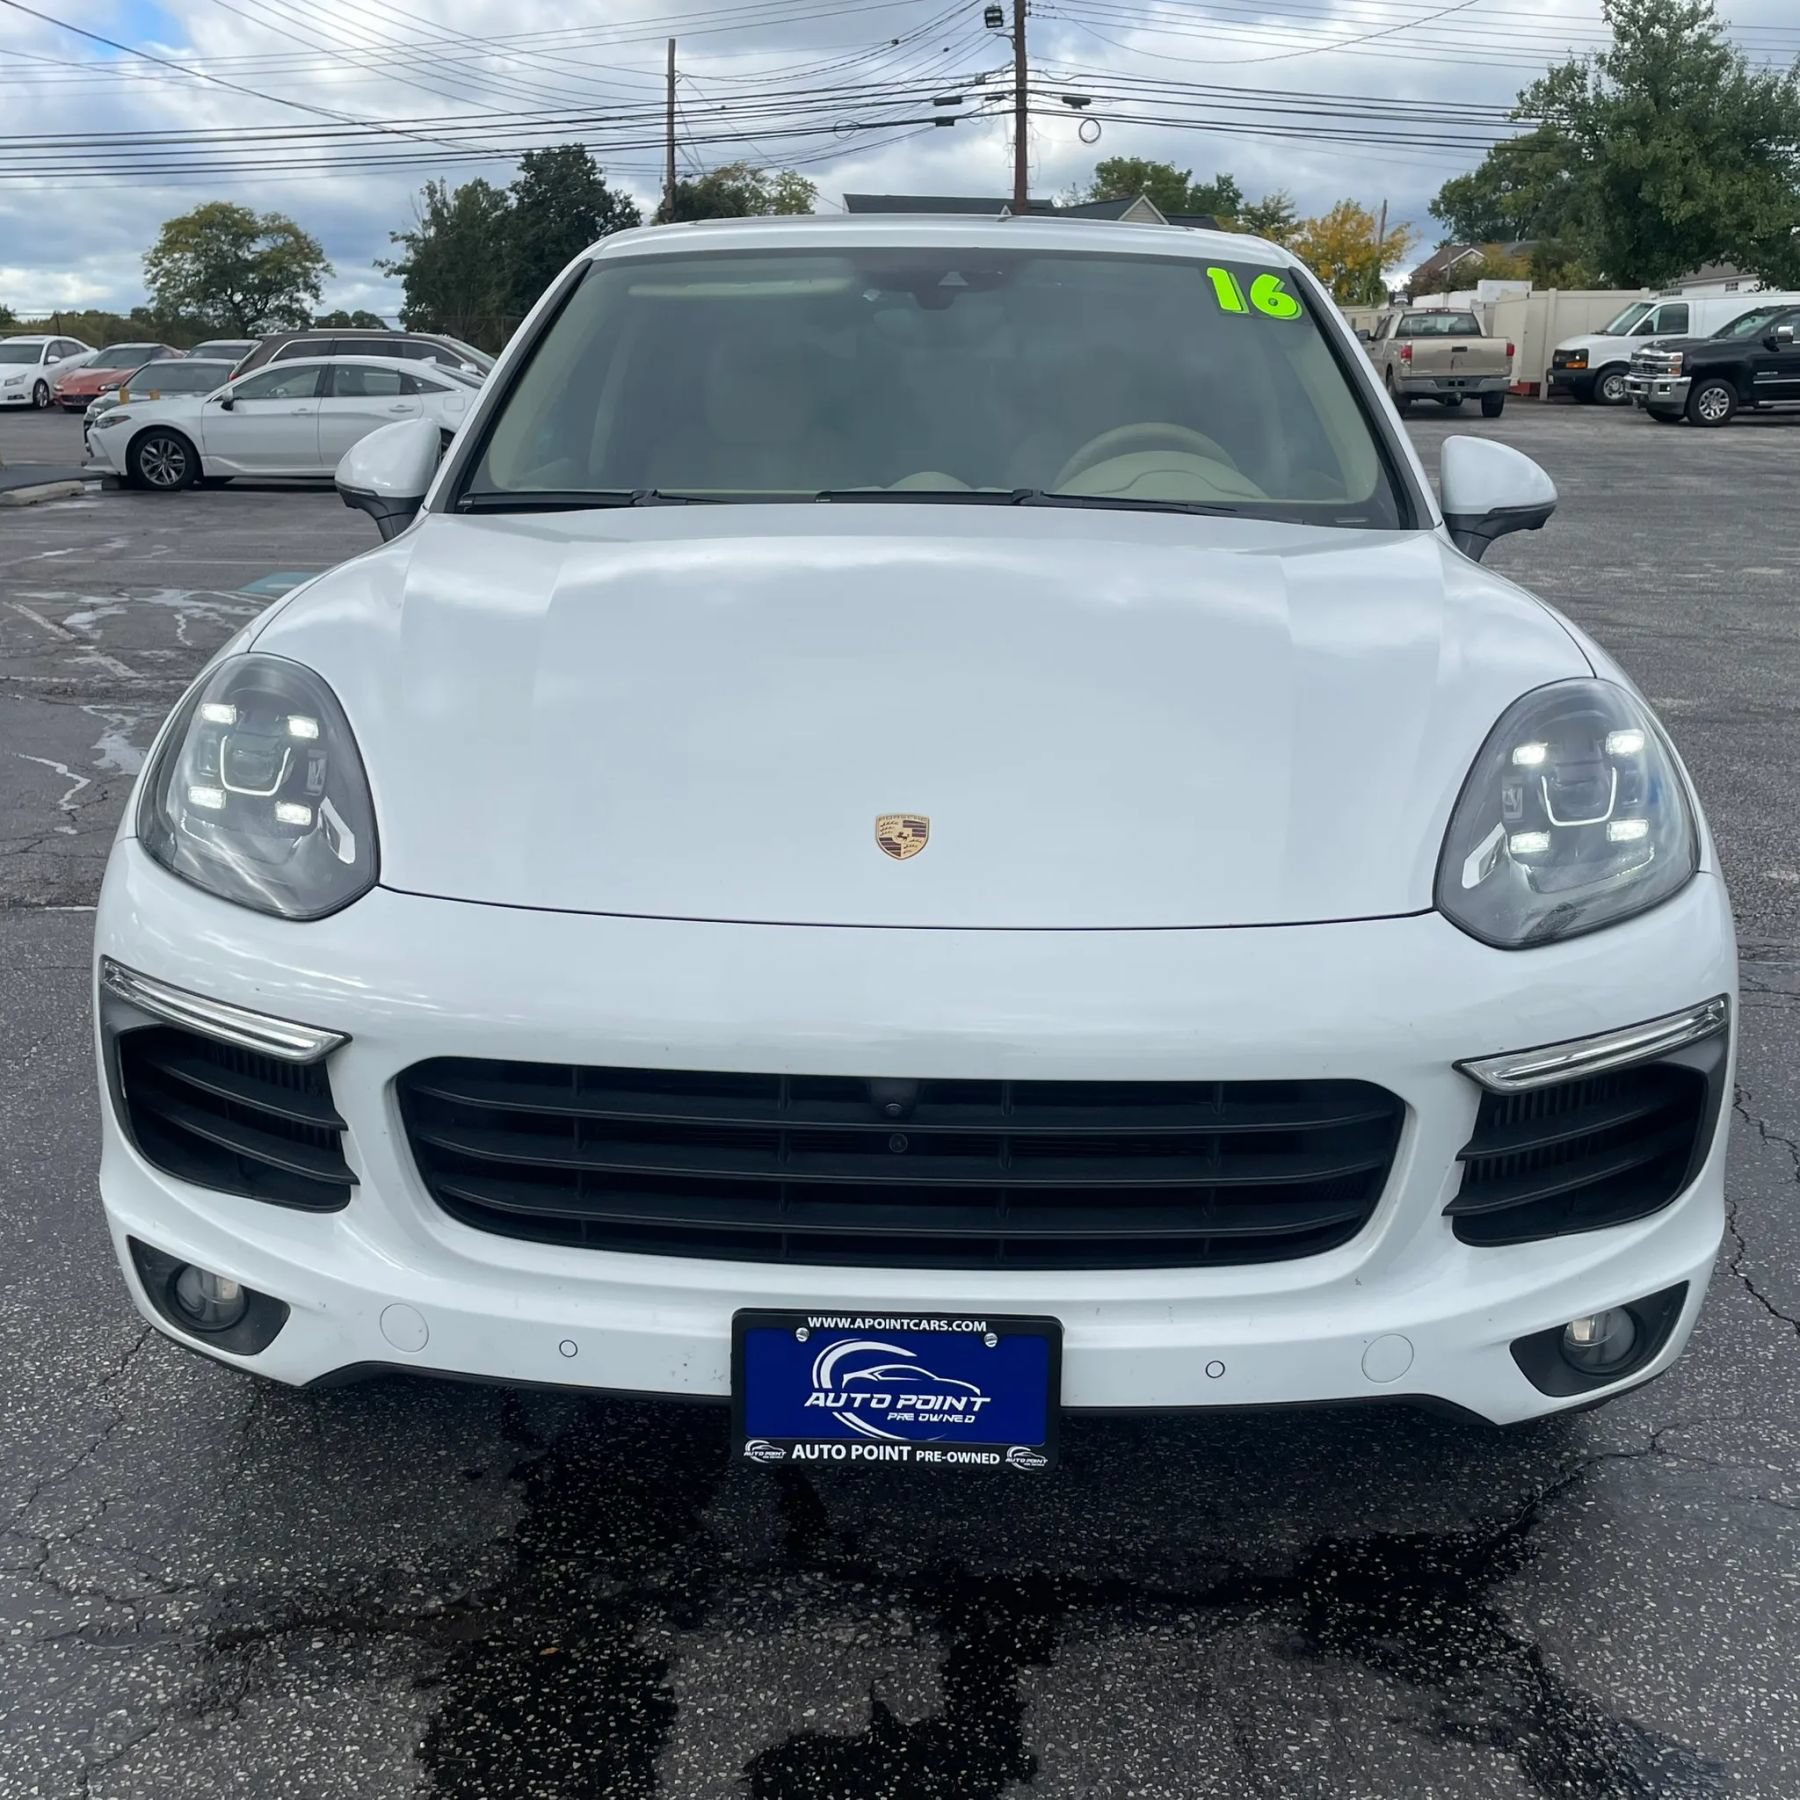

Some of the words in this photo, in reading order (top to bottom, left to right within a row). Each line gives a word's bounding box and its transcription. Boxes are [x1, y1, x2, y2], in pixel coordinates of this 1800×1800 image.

[1206, 266, 1303, 321] 16
[807, 1316, 987, 1332] WWW.APOINTCARS.COM
[804, 1392, 893, 1409] AUTO
[896, 1394, 992, 1412] POINT
[887, 1412, 915, 1421] PRE
[918, 1413, 976, 1423] OWNED
[791, 1444, 847, 1460] AUTO
[850, 1444, 912, 1461] POINT
[915, 1450, 1000, 1465] PRE-OWNED
